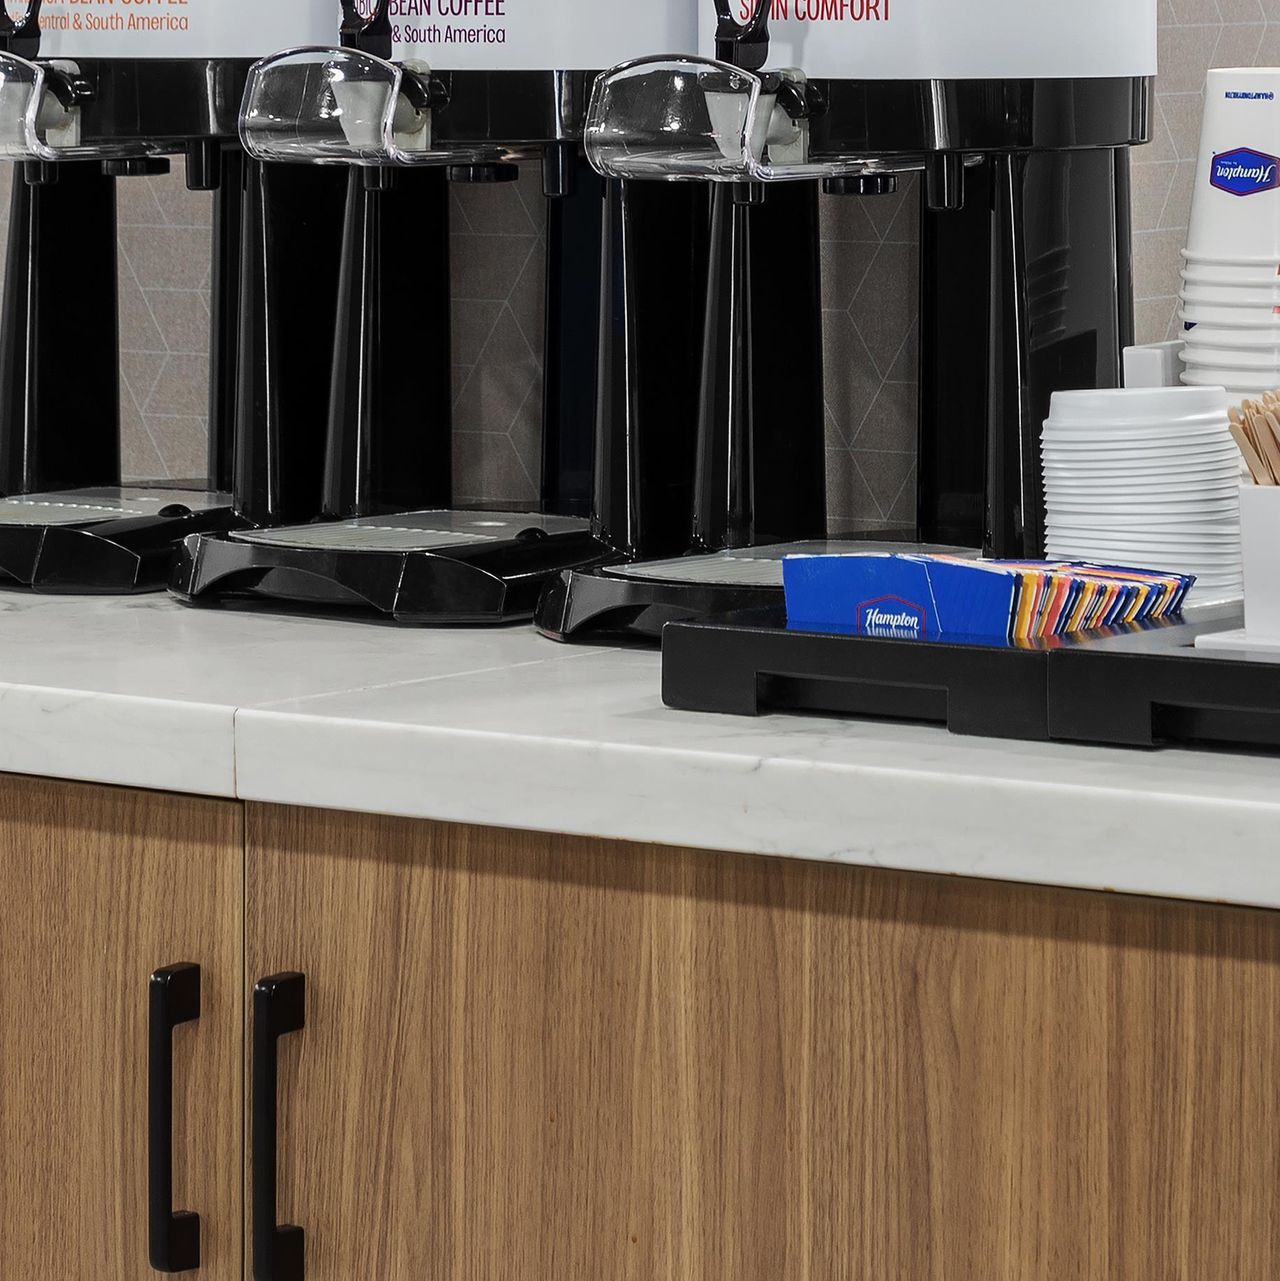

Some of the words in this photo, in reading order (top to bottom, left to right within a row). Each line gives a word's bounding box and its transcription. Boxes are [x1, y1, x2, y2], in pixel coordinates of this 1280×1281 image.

[40, 13, 70, 31] entral
[73, 13, 83, 31] &
[86, 13, 123, 31] South
[128, 13, 189, 31] America
[392, 24, 402, 44] &
[404, 24, 441, 44] South
[444, 24, 506, 44] America
[1216, 163, 1277, 183] Hampton
[865, 608, 920, 630] Hampton
